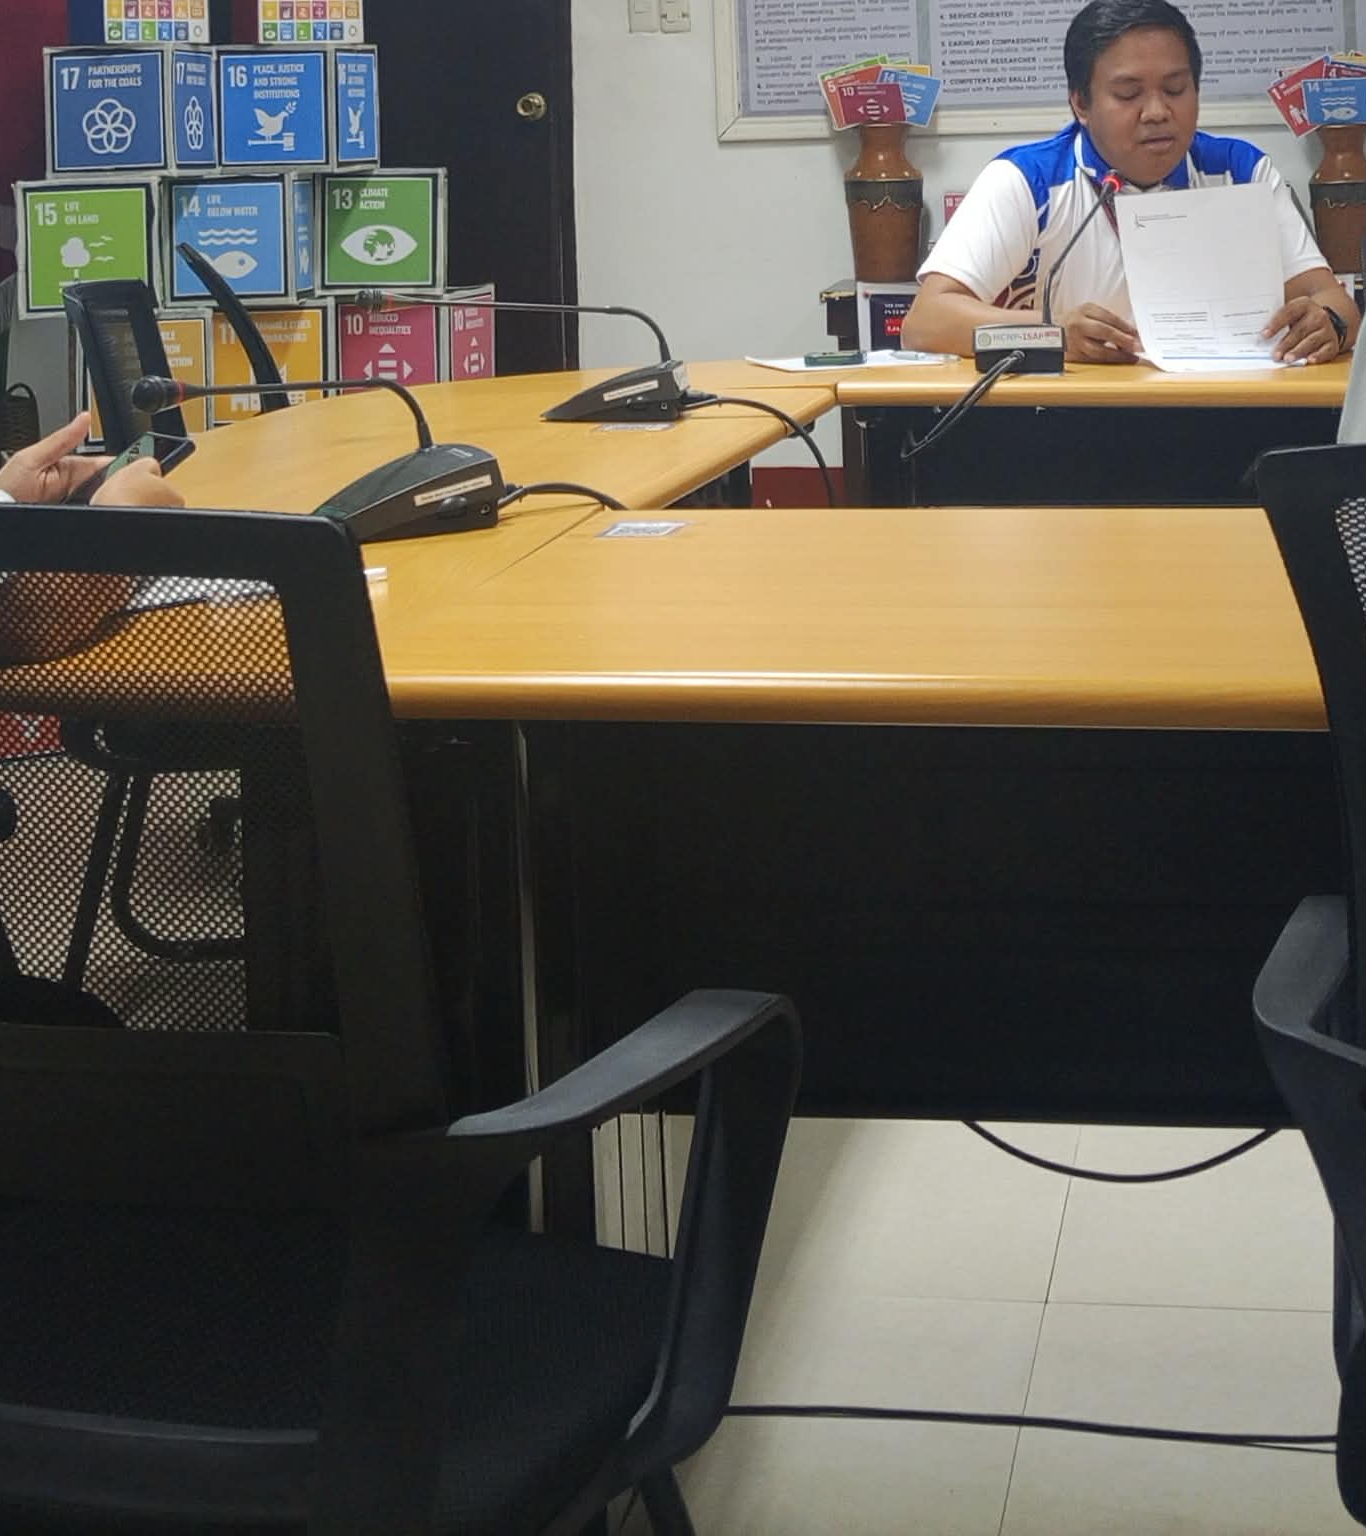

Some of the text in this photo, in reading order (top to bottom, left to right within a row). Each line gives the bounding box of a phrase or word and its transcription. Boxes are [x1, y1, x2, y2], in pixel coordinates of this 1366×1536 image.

[60, 66, 80, 90] 17
[88, 75, 142, 89] FOR THE GOALS
[227, 65, 248, 87] 16
[827, 81, 836, 93] 5
[842, 87, 854, 96] 10
[1307, 82, 1320, 93] 14
[332, 188, 353, 210] 13
[359, 187, 388, 198] CLIMATE
[180, 195, 201, 217] 14
[207, 194, 222, 205] LIFE
[359, 200, 386, 210] ACTION
[65, 201, 79, 212] LIFE
[35, 202, 57, 226] 15
[77, 214, 99, 224] LAND
[345, 314, 363, 335] 10
[453, 309, 464, 331] 10
